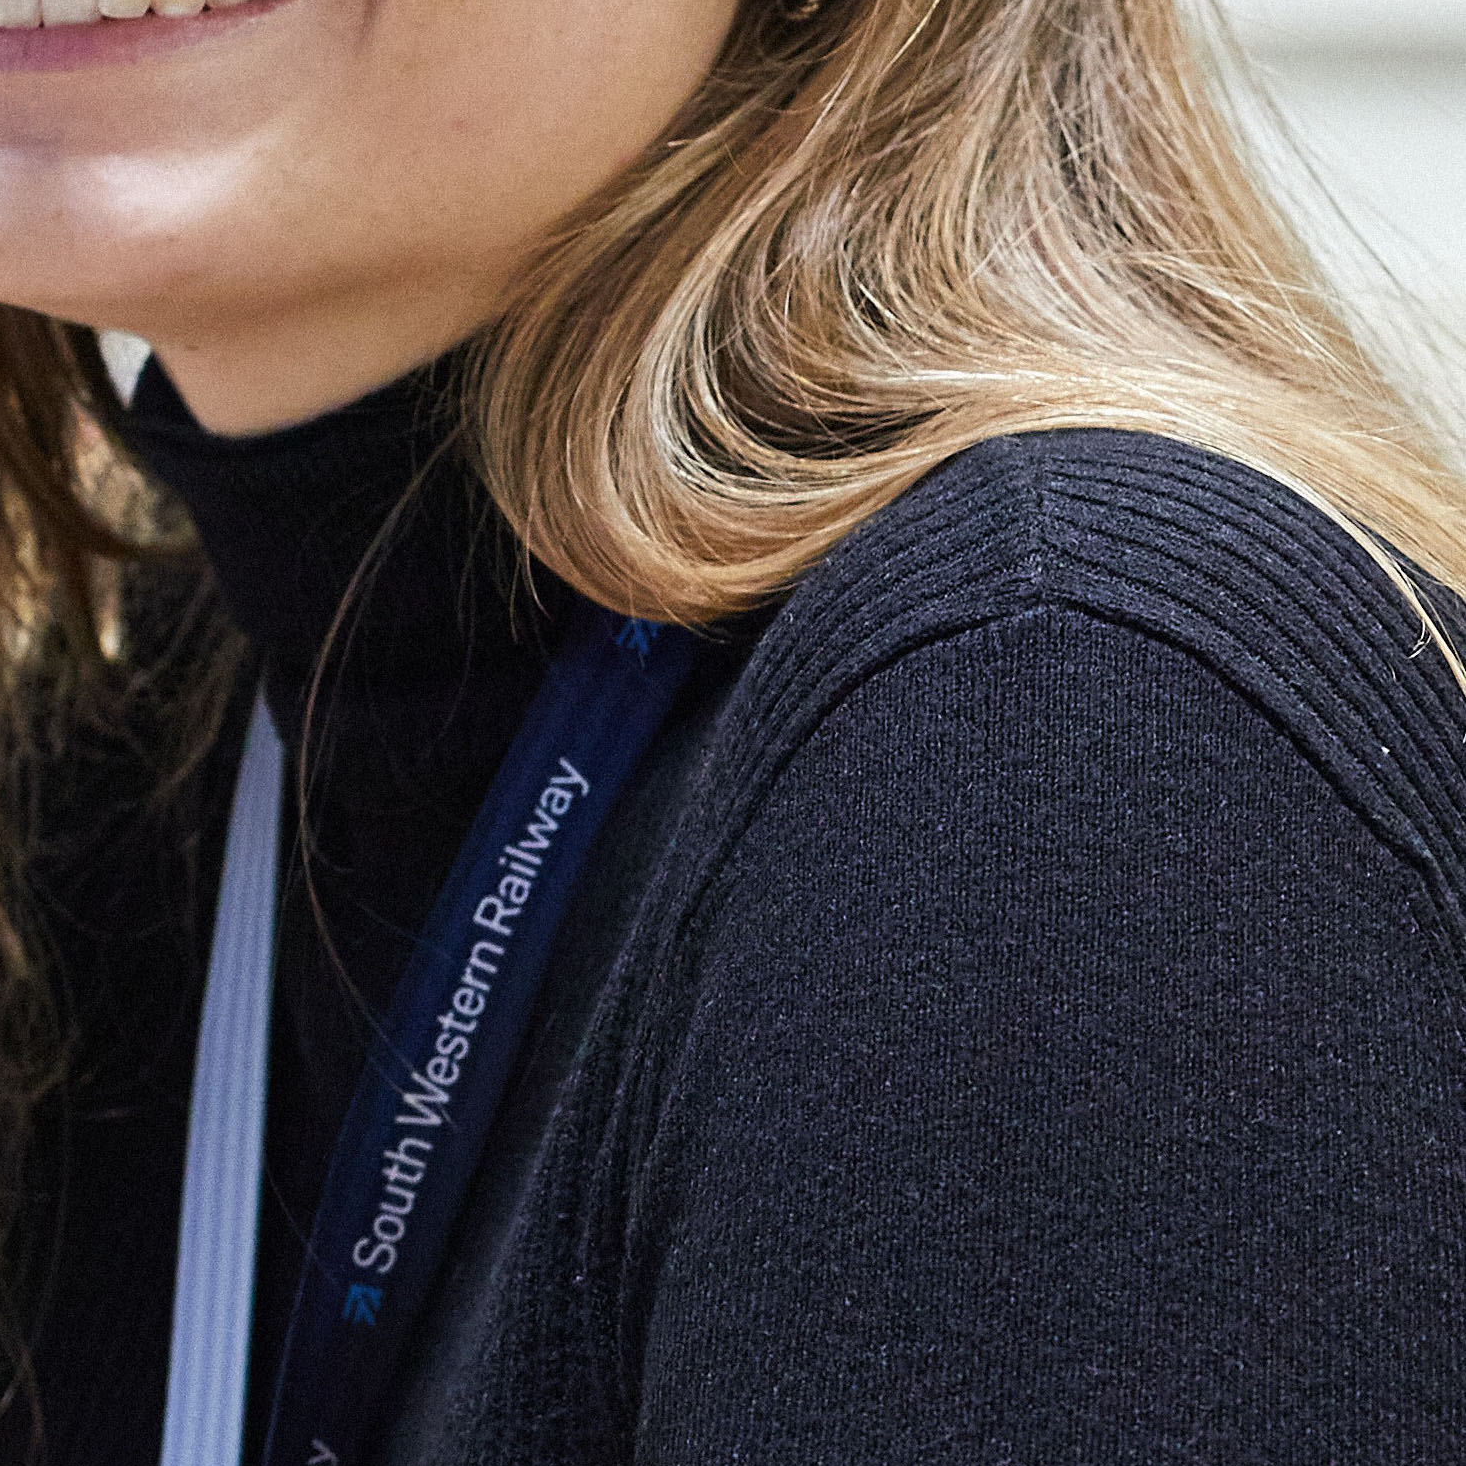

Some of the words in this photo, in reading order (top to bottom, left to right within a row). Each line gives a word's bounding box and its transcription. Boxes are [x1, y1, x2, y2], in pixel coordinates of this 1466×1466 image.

[352, 1136, 434, 1275] South
[394, 940, 506, 1127] Western
[472, 756, 590, 936] Railway
